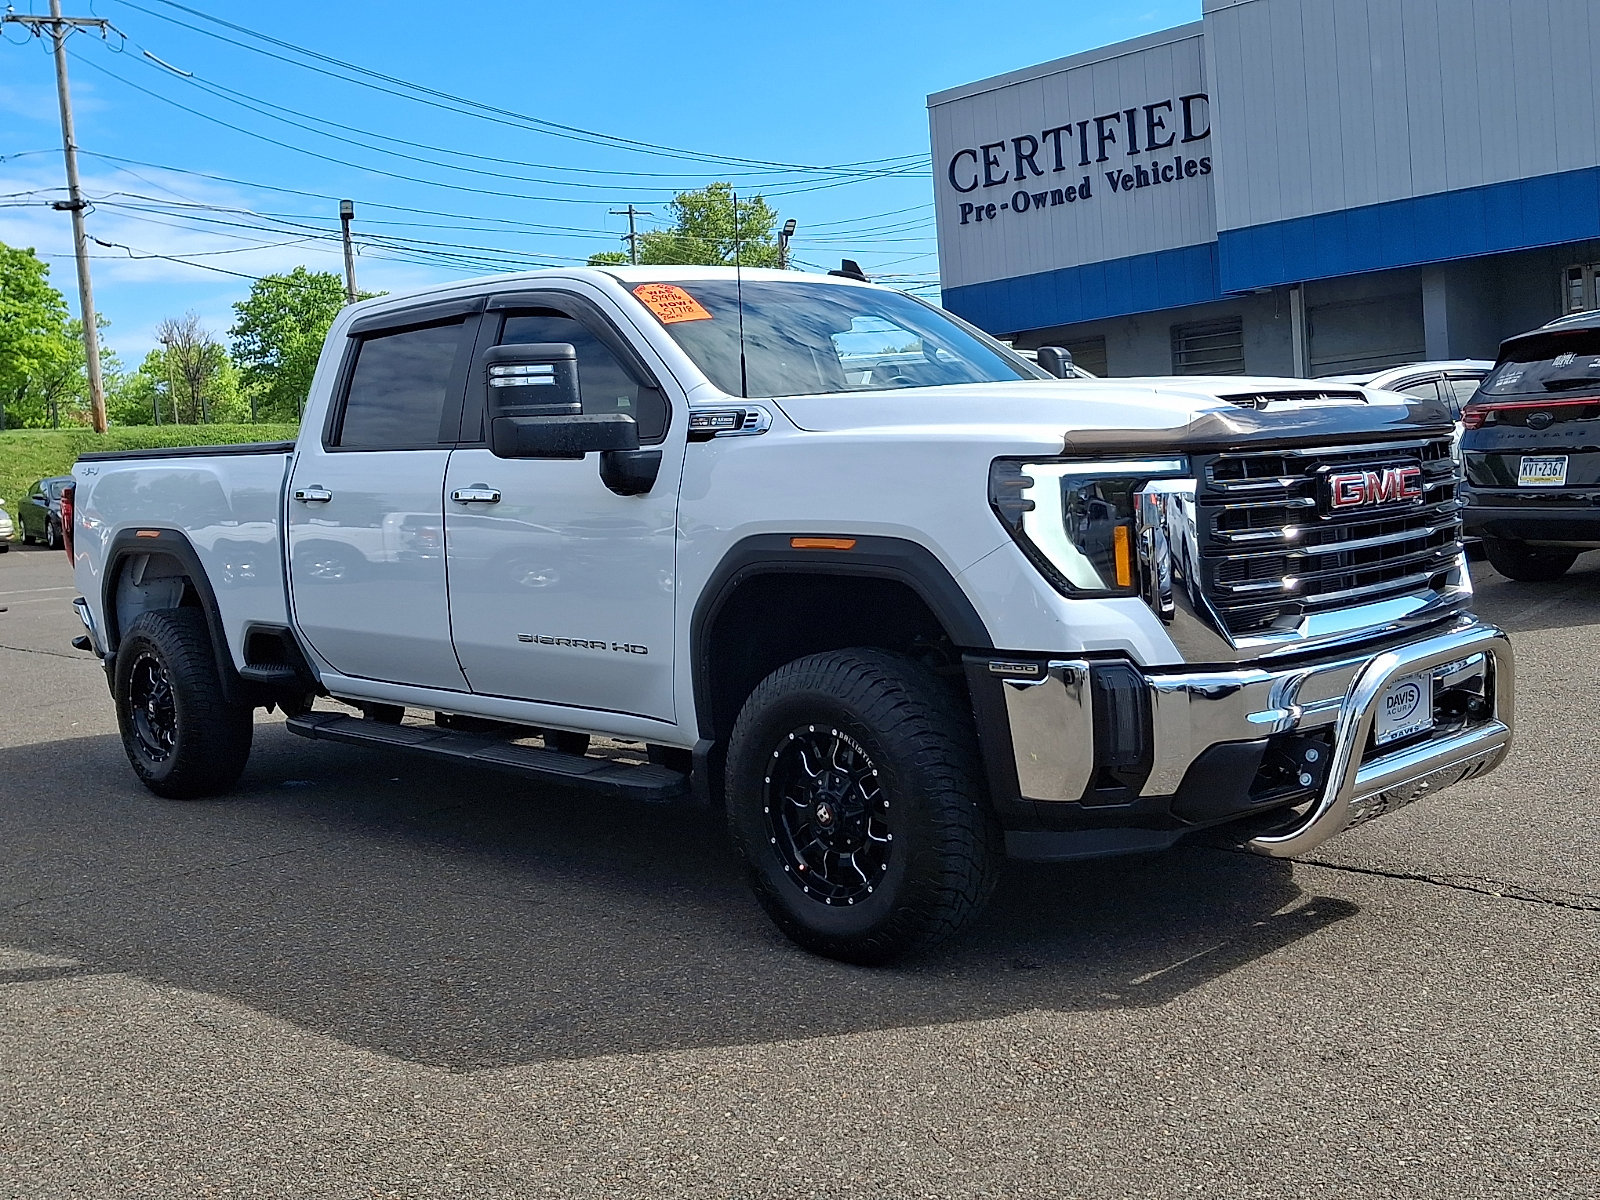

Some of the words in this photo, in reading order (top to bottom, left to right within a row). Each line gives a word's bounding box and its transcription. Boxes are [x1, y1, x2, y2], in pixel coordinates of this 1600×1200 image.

[948, 93, 1211, 193] CERTIFIED
[959, 175, 1092, 225] Pre-Owned
[1105, 155, 1212, 193] Vehicles
[1330, 466, 1421, 509] GMC
[517, 632, 607, 650] SIERRA
[611, 642, 649, 655] HD
[1386, 689, 1415, 709] DAVIS
[1386, 703, 1412, 717] ACURA
[1390, 725, 1420, 740] DAVIS
[838, 731, 875, 768] BALLISTIC
